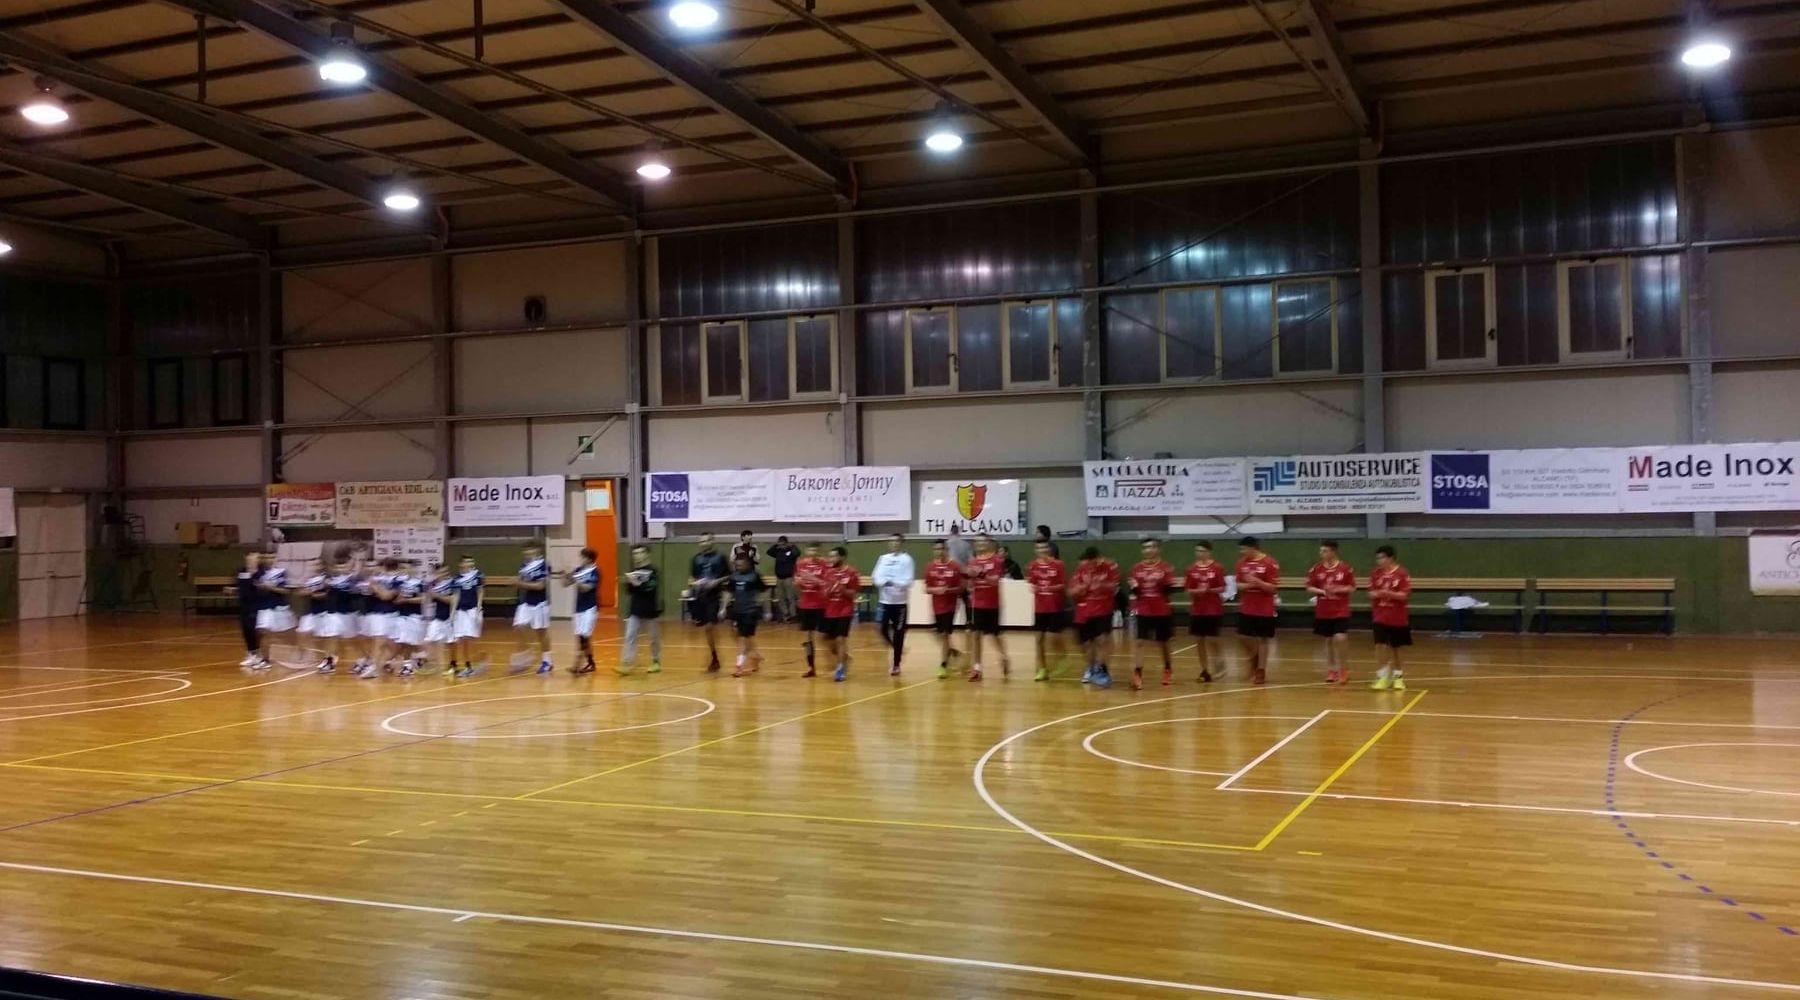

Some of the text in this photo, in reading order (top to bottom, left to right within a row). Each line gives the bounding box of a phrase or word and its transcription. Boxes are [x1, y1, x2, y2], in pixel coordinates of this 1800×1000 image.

[1298, 459, 1421, 478] AUTOSERVICE
[1628, 453, 1793, 479] Made Inox
[850, 473, 893, 496] Jonny
[1113, 479, 1167, 499] PIAZZA
[1433, 475, 1489, 489] STOSA
[454, 485, 500, 501] Made
[505, 484, 543, 500] Inox
[651, 490, 688, 503] STOSA
[926, 519, 1013, 533] TH ALCAMO
